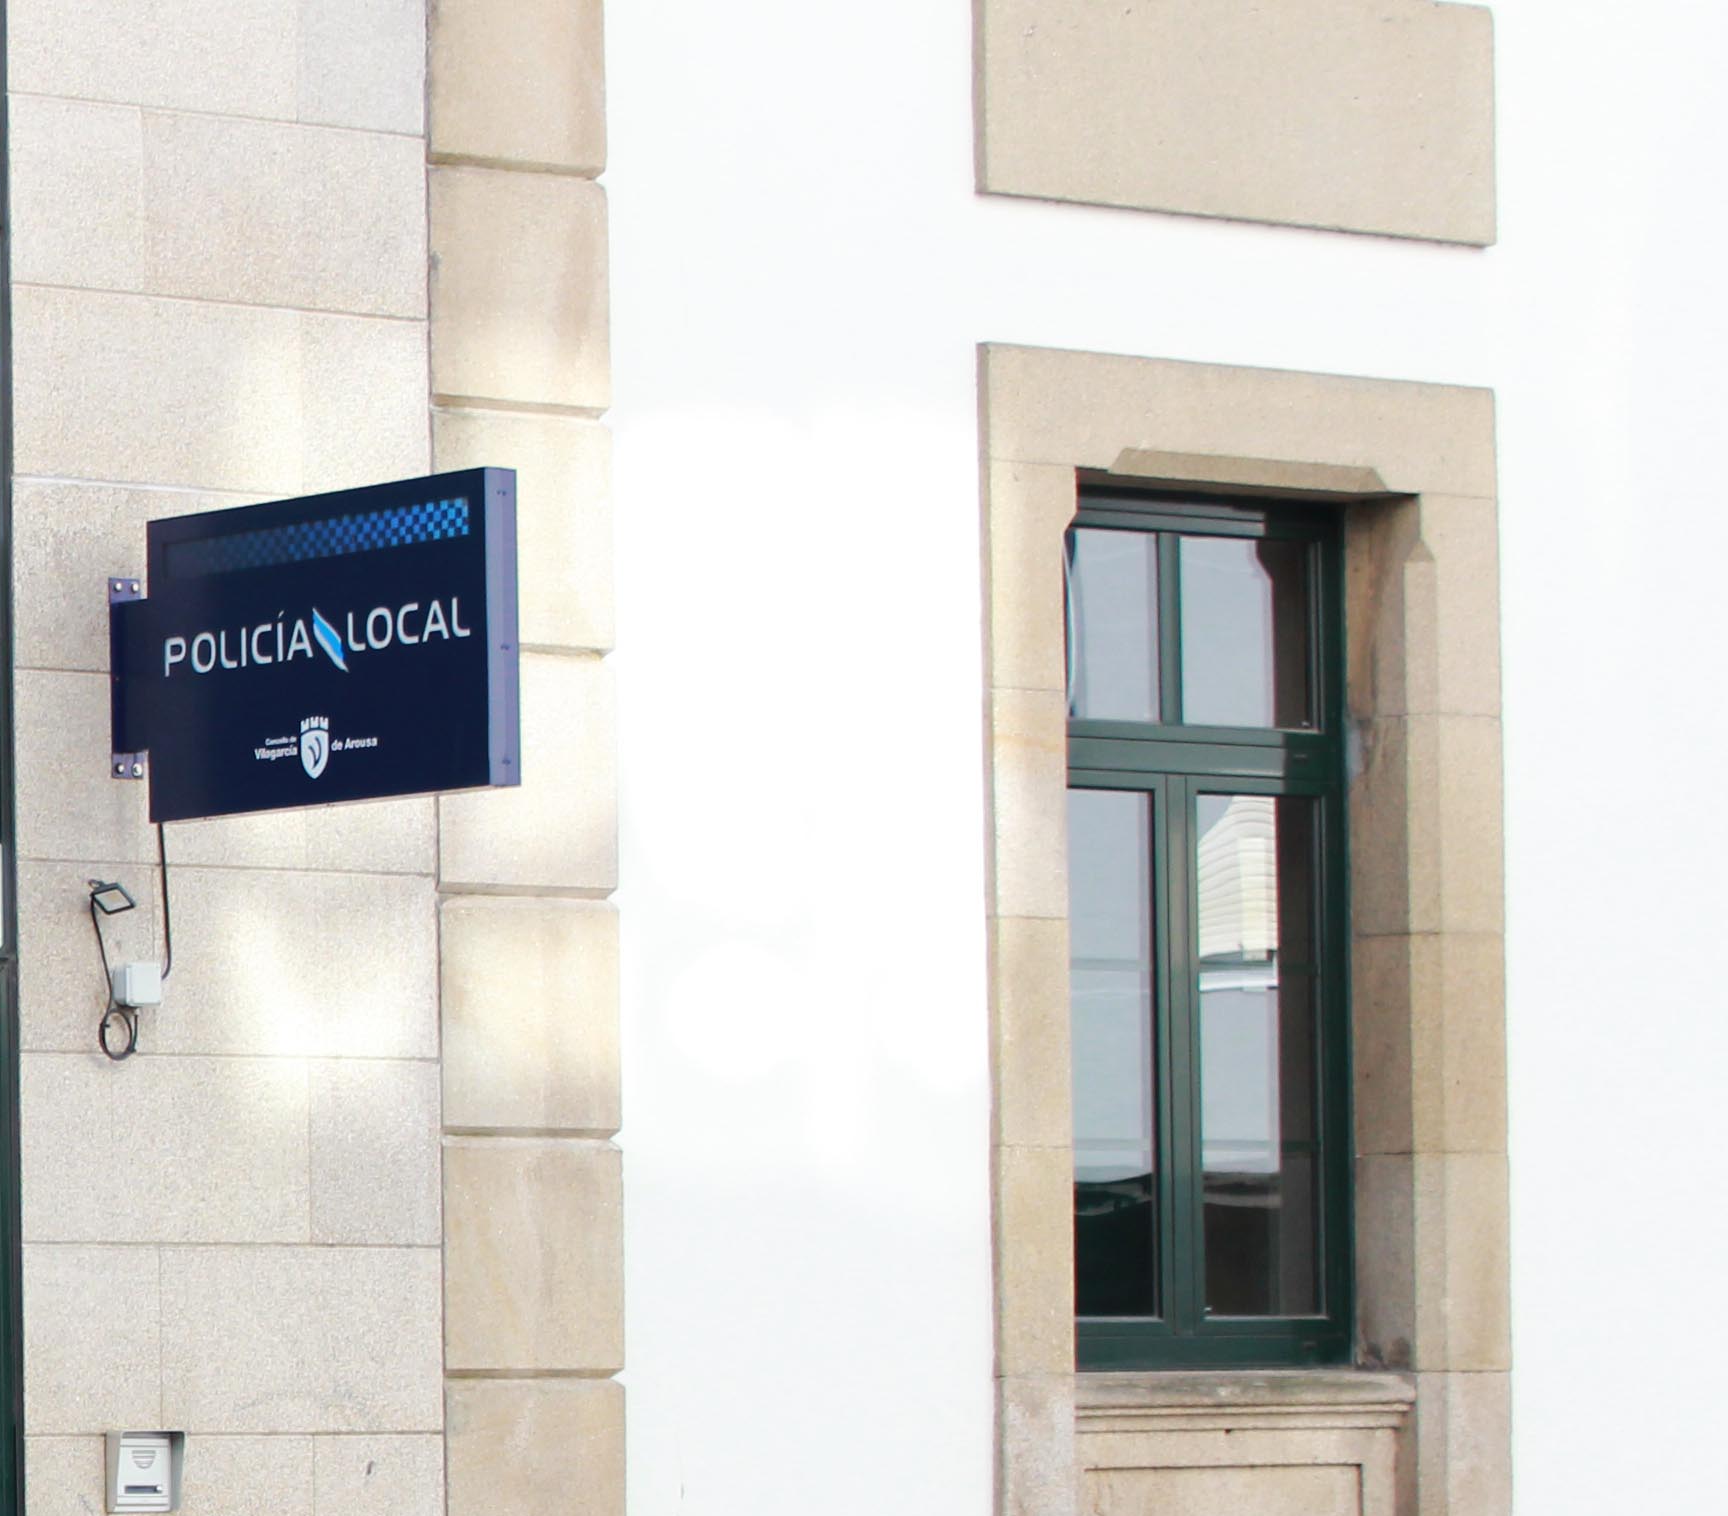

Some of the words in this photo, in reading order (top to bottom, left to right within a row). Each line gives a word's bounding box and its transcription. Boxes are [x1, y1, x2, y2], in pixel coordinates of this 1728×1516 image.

[164, 610, 313, 677] POLICÍA
[347, 597, 471, 652] LOCAL
[331, 740, 343, 751] de
[344, 737, 378, 750] Arousa
